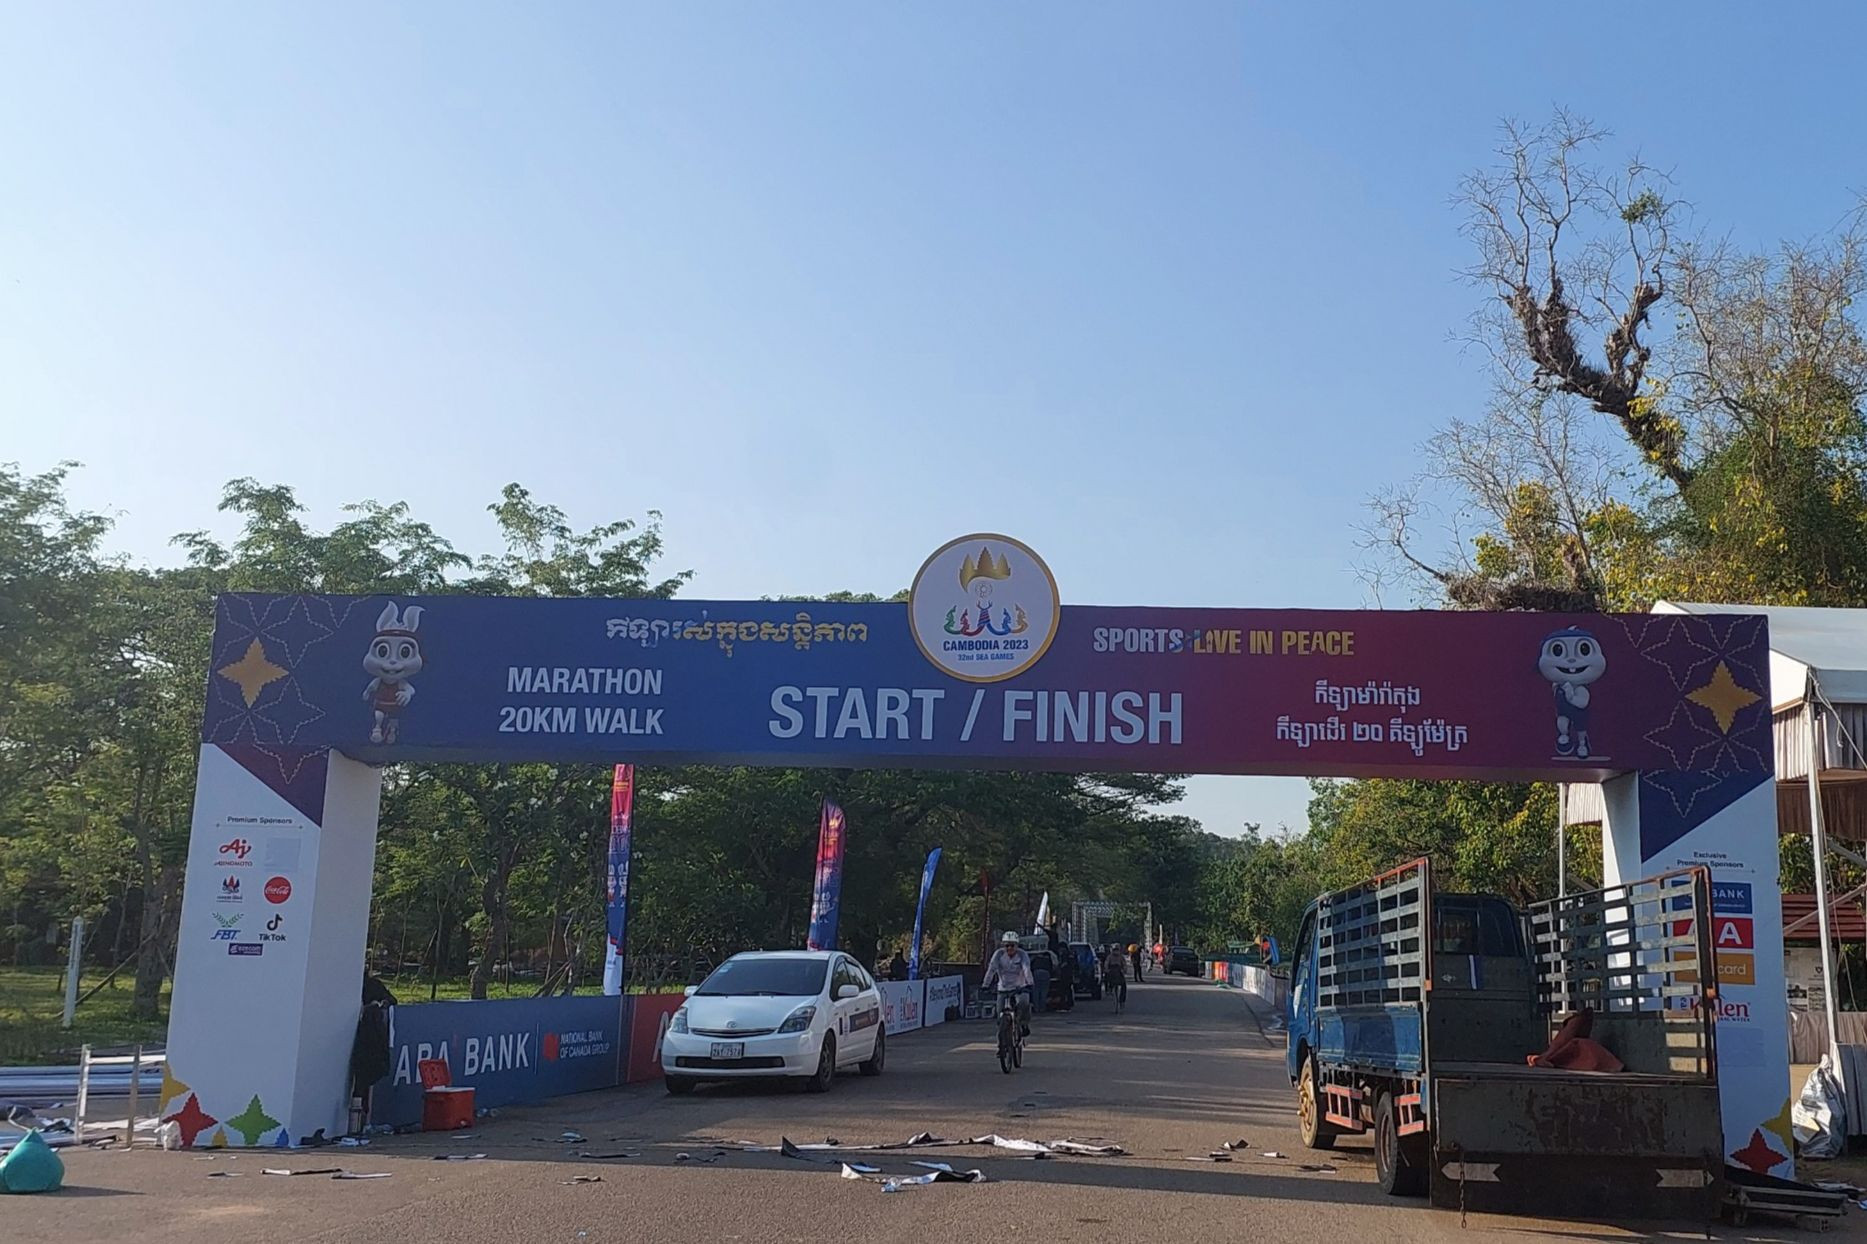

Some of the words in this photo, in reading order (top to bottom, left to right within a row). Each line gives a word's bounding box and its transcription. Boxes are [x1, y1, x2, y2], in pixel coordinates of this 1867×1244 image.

[943, 640, 1000, 651] CAMBODIA
[1002, 639, 1029, 650] 2023
[1093, 628, 1184, 653] SPORTS
[1194, 629, 1242, 654] LIVE
[1250, 630, 1273, 654] IN
[1282, 630, 1354, 655] PEACE
[507, 667, 663, 695] MARATHON
[499, 706, 577, 733] 20KM
[584, 707, 665, 734] WALK
[768, 685, 945, 739] START
[960, 689, 986, 742] /
[1003, 690, 1183, 744] FINISH
[1352, 722, 1383, 742] ២០
[259, 816, 293, 824] Sponsors
[211, 929, 241, 940] FBT
[560, 1031, 588, 1044] NATIONAL
[588, 1030, 604, 1042] BANK
[464, 1033, 530, 1076] BANK
[560, 1046, 569, 1058] OF
[569, 1045, 591, 1058] CANADA
[592, 1043, 610, 1056] GROUP
